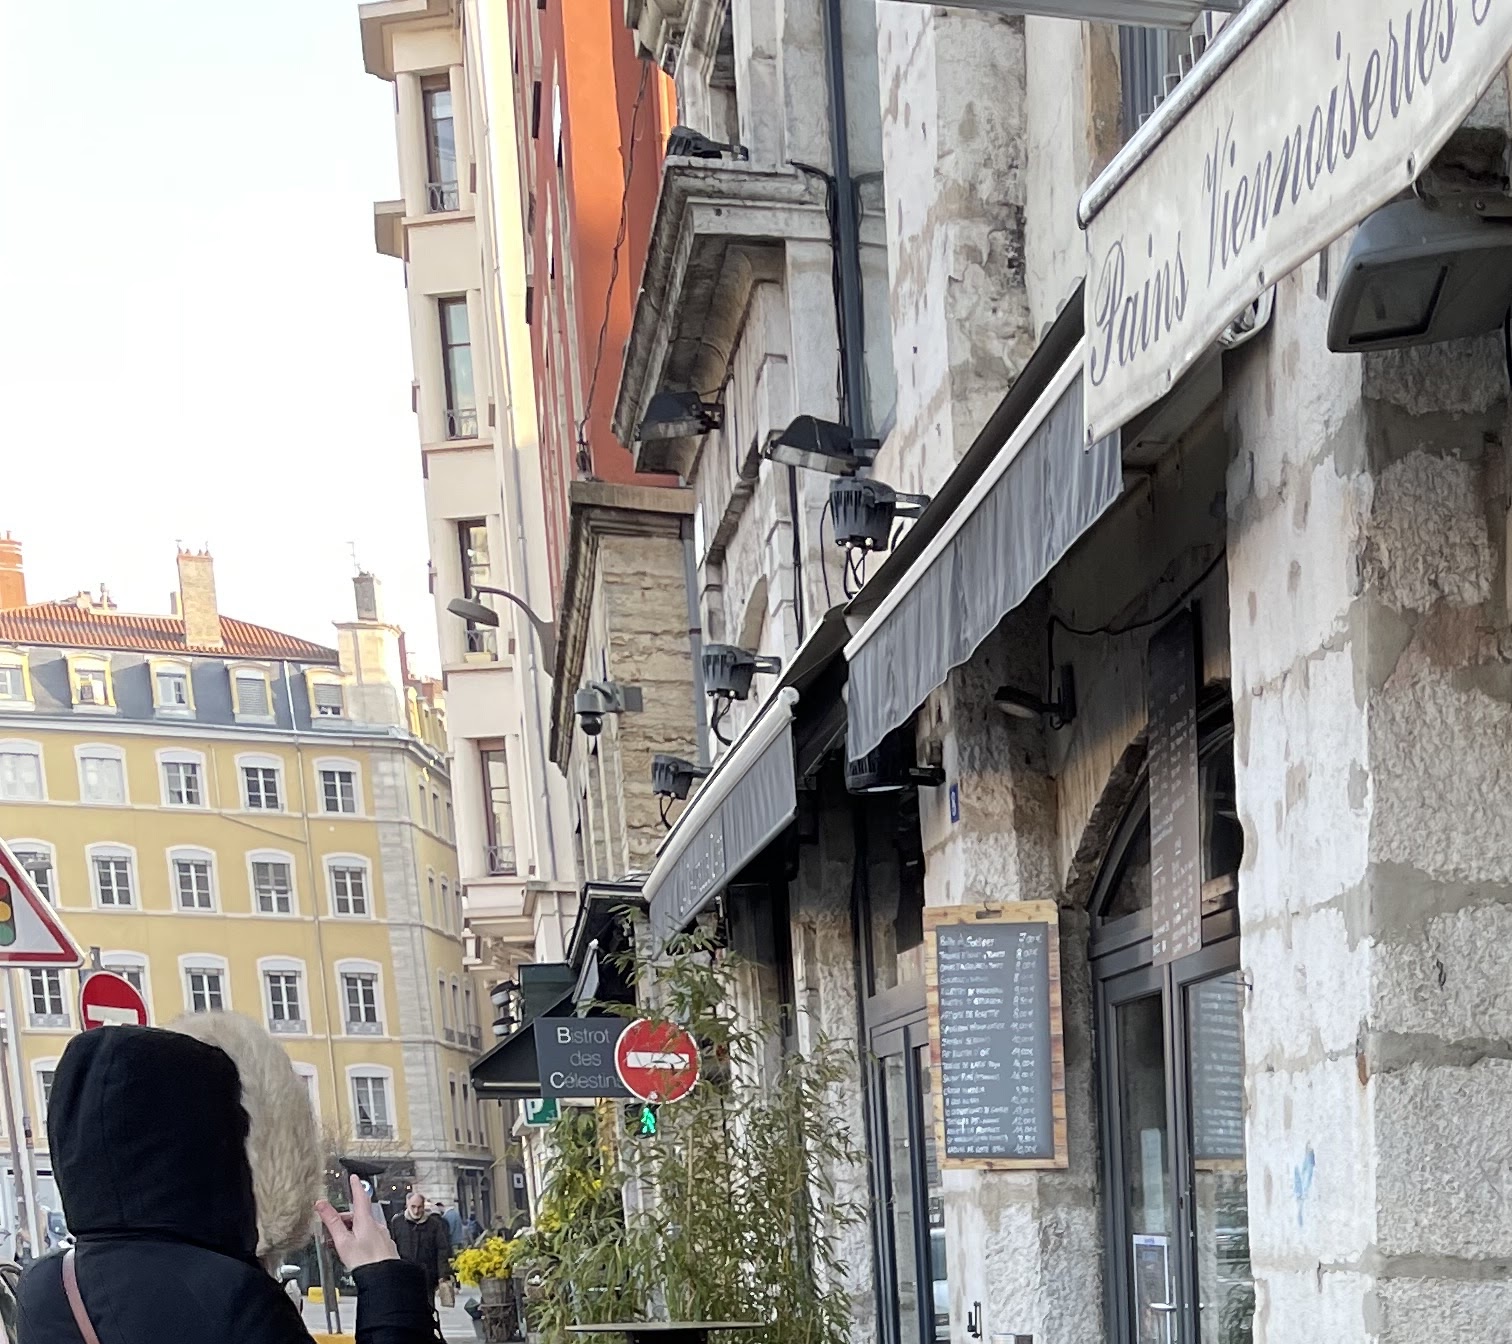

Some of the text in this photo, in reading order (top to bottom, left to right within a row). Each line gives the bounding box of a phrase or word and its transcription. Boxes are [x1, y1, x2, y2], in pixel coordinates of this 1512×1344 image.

[1089, 0, 1458, 386] Pains Viennoiseries
[556, 1026, 611, 1044] Bistrot
[569, 1051, 602, 1067] des
